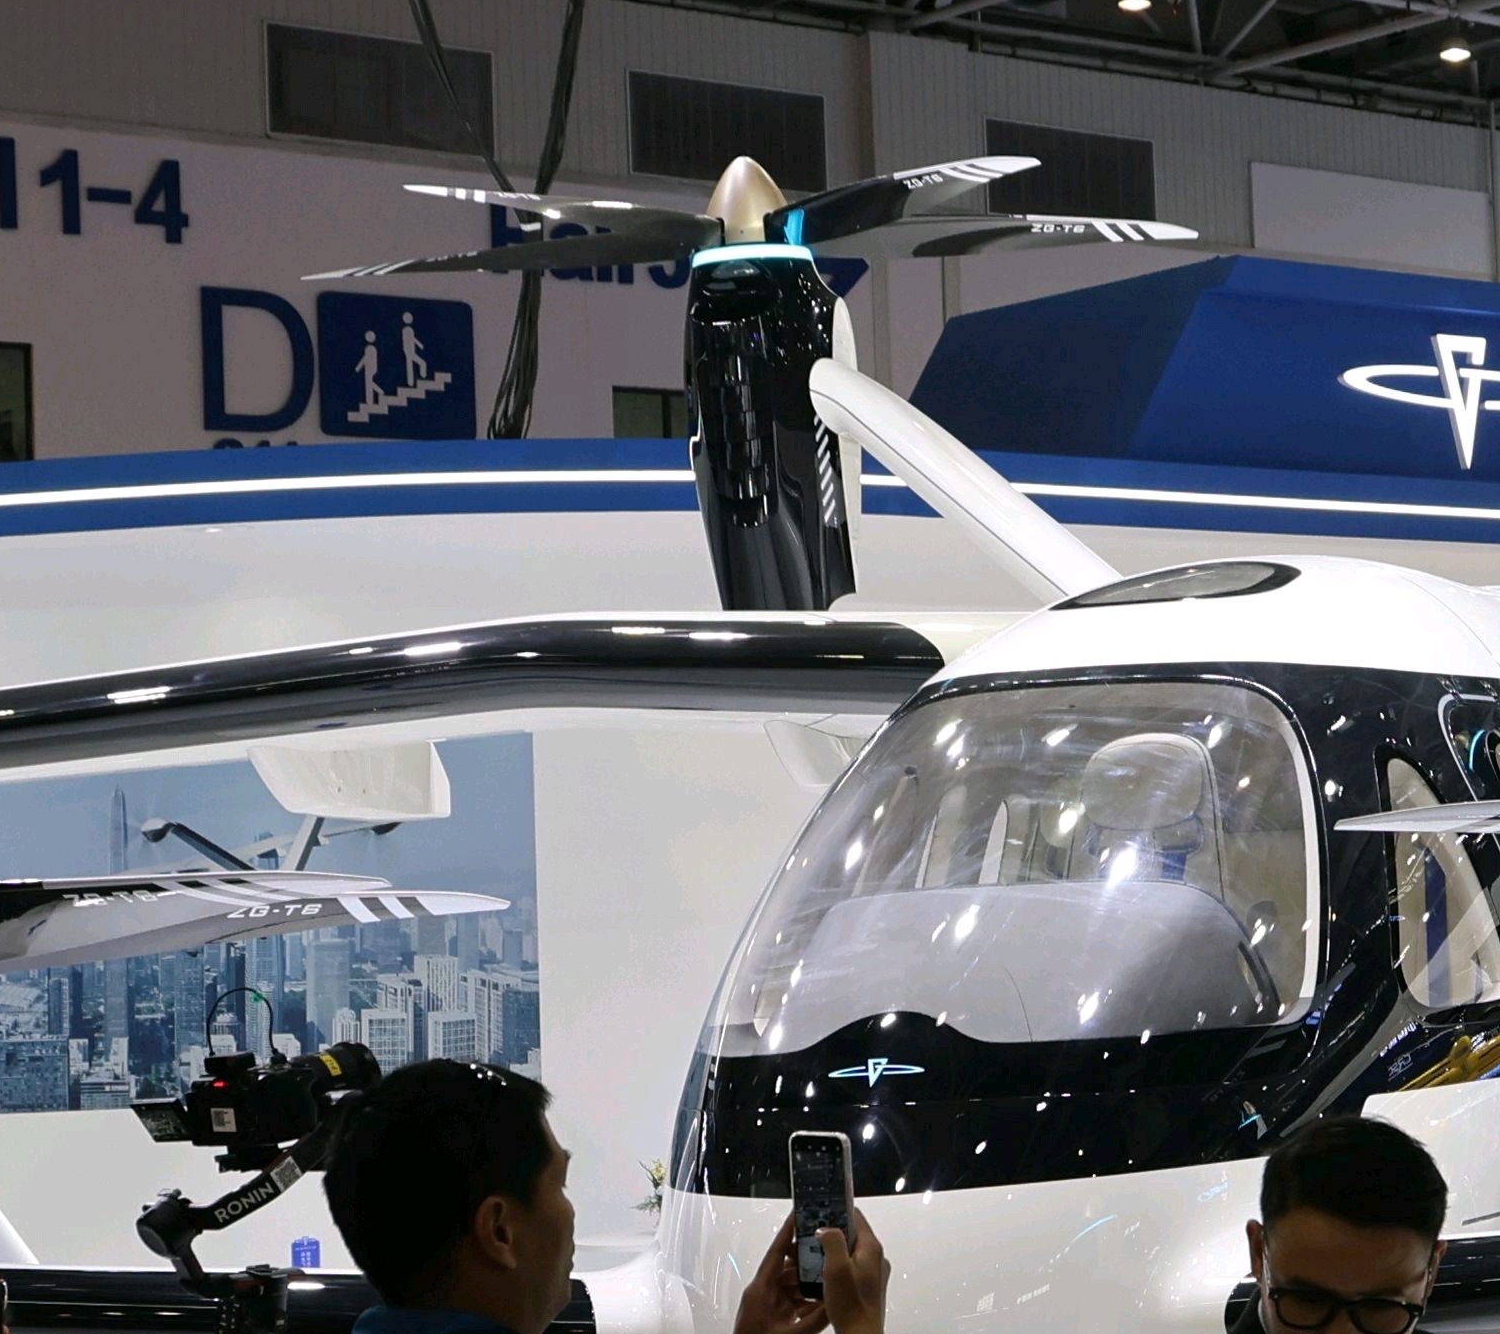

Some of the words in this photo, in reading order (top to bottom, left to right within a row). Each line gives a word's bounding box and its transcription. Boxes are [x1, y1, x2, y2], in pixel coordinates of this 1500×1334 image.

[39, 148, 190, 245] 1-4
[200, 286, 315, 433] D
[214, 1182, 275, 1223] RONIN
